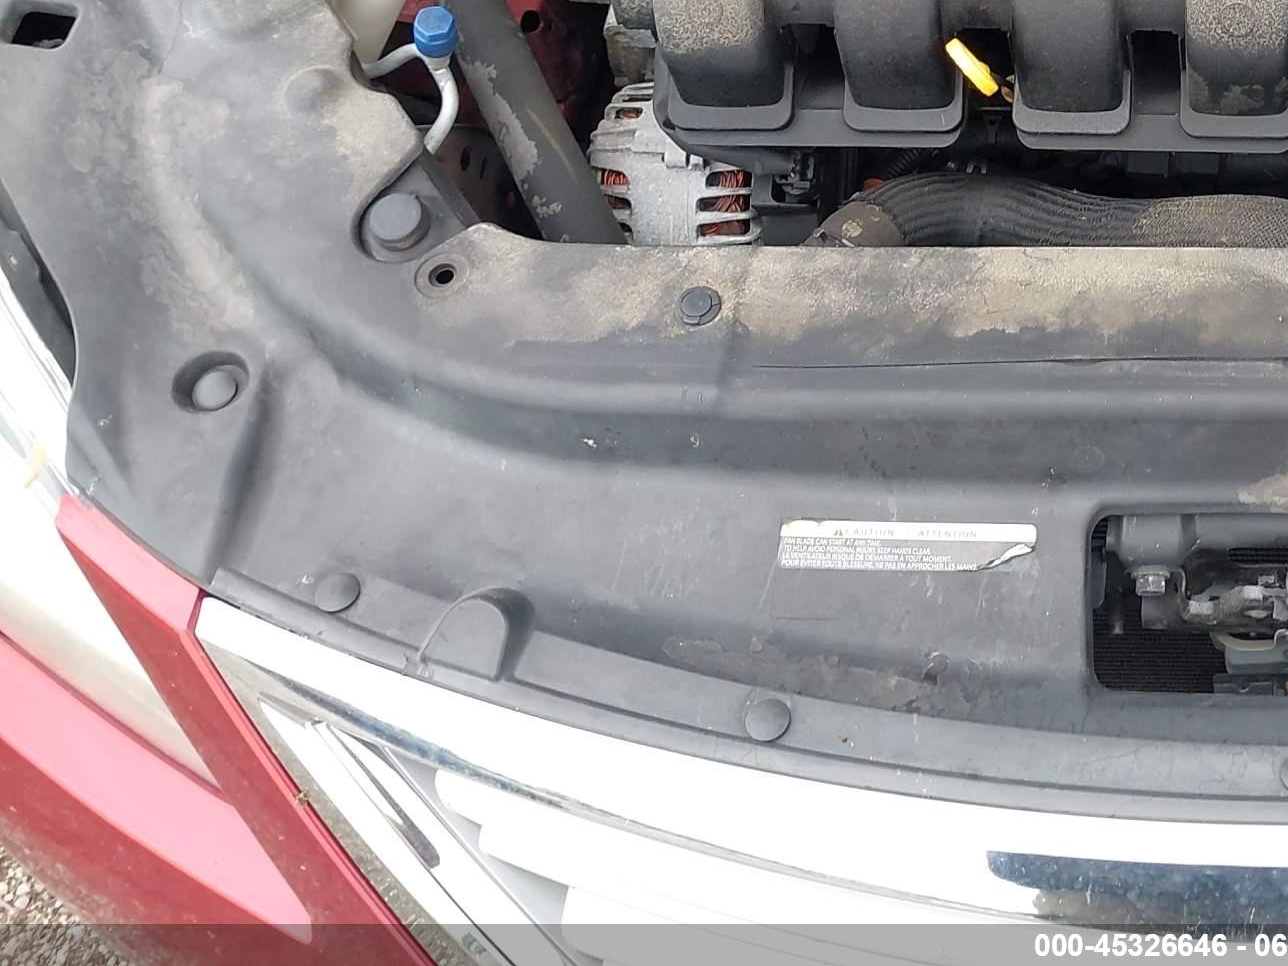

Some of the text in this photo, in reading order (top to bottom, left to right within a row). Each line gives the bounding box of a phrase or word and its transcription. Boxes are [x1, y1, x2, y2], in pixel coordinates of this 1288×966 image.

[845, 528, 978, 538] CAUTION ATTENTION
[790, 552, 831, 560] VENTILATEUR
